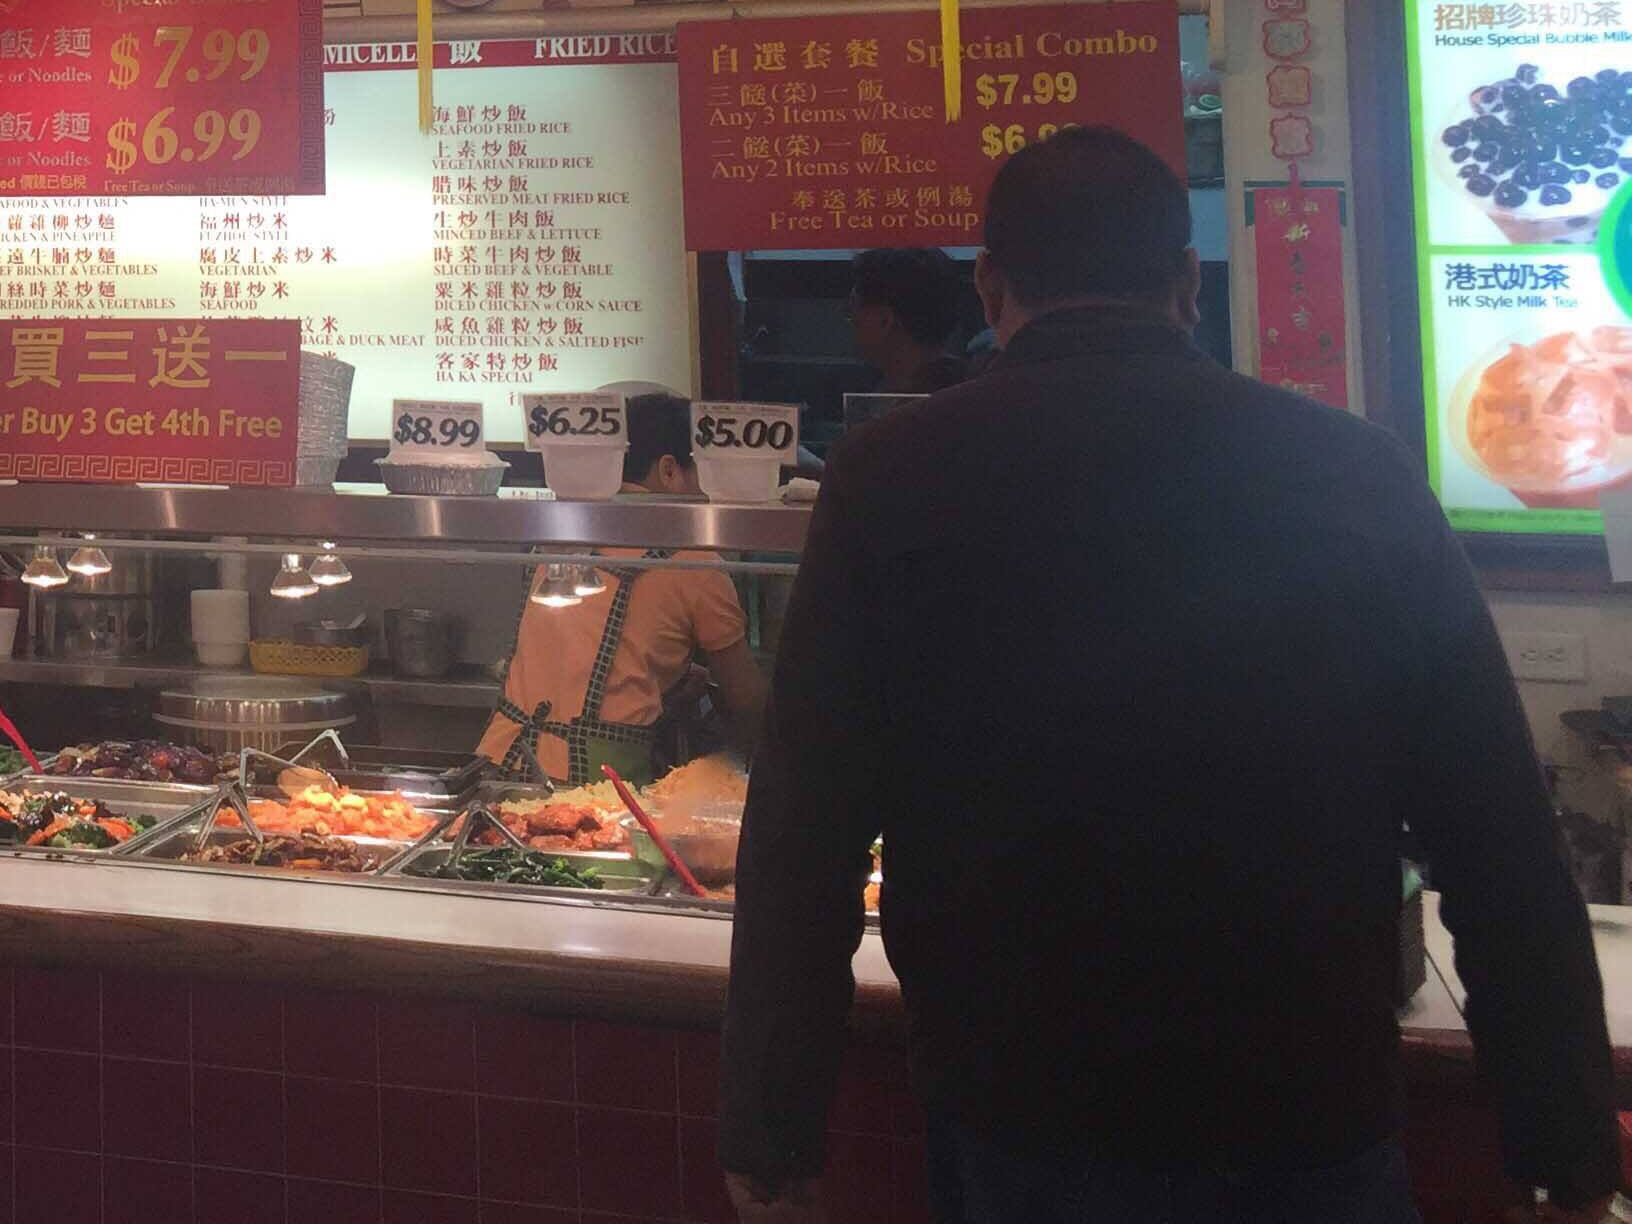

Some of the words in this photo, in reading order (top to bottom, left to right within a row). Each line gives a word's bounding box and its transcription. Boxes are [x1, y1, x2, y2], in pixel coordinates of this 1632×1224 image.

[1434, 1, 1622, 31] 招牌珍珠奶茶
[534, 35, 611, 58] FRIED
[617, 32, 679, 56] RICE
[1435, 34, 1483, 46] House
[1487, 32, 1540, 47] Special
[1545, 32, 1599, 44] Bubble
[107, 25, 271, 91] $7.99
[448, 40, 483, 65] 飯
[711, 38, 880, 74] 自選套餐
[1036, 29, 1159, 57] Combo
[27, 66, 93, 83] Noodles
[975, 71, 1079, 110] $7.99
[432, 104, 527, 123] 海鮮炒飯
[709, 107, 757, 129] Any
[763, 106, 776, 125] 3
[783, 105, 847, 125] Items
[432, 123, 493, 135] SEAFOOD
[496, 123, 536, 134] FRIED
[539, 122, 572, 133] RICE
[105, 106, 262, 175] $6.99
[437, 139, 528, 158] 上素炒飯
[27, 151, 93, 167] Noodles
[432, 159, 514, 170] VEGETARIAN
[518, 158, 558, 169] FRIED
[562, 157, 594, 168] RICE
[711, 159, 759, 183] Any
[766, 159, 778, 178] 2
[784, 158, 850, 178] Items
[53, 198, 128, 208] VEGETABLES
[432, 193, 508, 205] PRESERVED
[512, 193, 549, 205] MEAT
[553, 192, 594, 204] FRIED
[597, 192, 630, 203] RICE
[791, 185, 973, 210] 奉送茶或例湯
[434, 210, 555, 228] 生炒牛肉飯
[770, 211, 823, 231] Free
[829, 210, 873, 229] Tea
[881, 213, 908, 228] or
[913, 208, 980, 231] Soup
[52, 231, 118, 242] PINEAPPLE
[433, 229, 486, 240] MINCED
[490, 229, 522, 240] BEEF
[528, 229, 536, 240] &
[540, 228, 602, 240] LETTUCE
[434, 245, 582, 263] 時菜牛肉炒飯
[16, 265, 67, 276] BRISKET
[70, 265, 79, 276] &
[82, 264, 159, 276] VEGETABLES
[200, 265, 278, 276] VEGETARIAN
[433, 264, 481, 276] SLICED
[485, 264, 518, 276] BEEF
[522, 264, 531, 275] &
[535, 263, 614, 276] VEGETABLE
[1445, 263, 1570, 291] 港式奶茶
[200, 280, 290, 299] 海鮮炒米
[51, 299, 84, 310] PORK
[87, 299, 96, 309] &
[99, 297, 177, 309] VEGETABLES
[200, 299, 258, 311] SEAFOOD
[435, 300, 476, 311] DICED
[479, 300, 539, 311] CHICKEN
[598, 300, 643, 312] SAUCE
[1447, 295, 1470, 308] HK
[1475, 295, 1513, 309] Style
[1517, 294, 1547, 308] Milk
[337, 335, 345, 345] &
[349, 335, 385, 346] DUCK
[389, 335, 425, 346] MEAT
[435, 336, 477, 346] DICED
[479, 336, 540, 347] CHICKEN
[544, 336, 554, 347] &
[558, 336, 609, 348] SALTED
[435, 352, 558, 371] 客家特炒飯
[480, 371, 533, 383] SPECIAL
[21, 406, 72, 442] Buy
[81, 408, 96, 436] 3
[104, 407, 155, 436] Get
[161, 406, 209, 437] 4th
[219, 409, 282, 439] Free
[393, 412, 480, 447] $8.99
[528, 404, 620, 437] $6.25
[693, 414, 794, 450] $5.00
